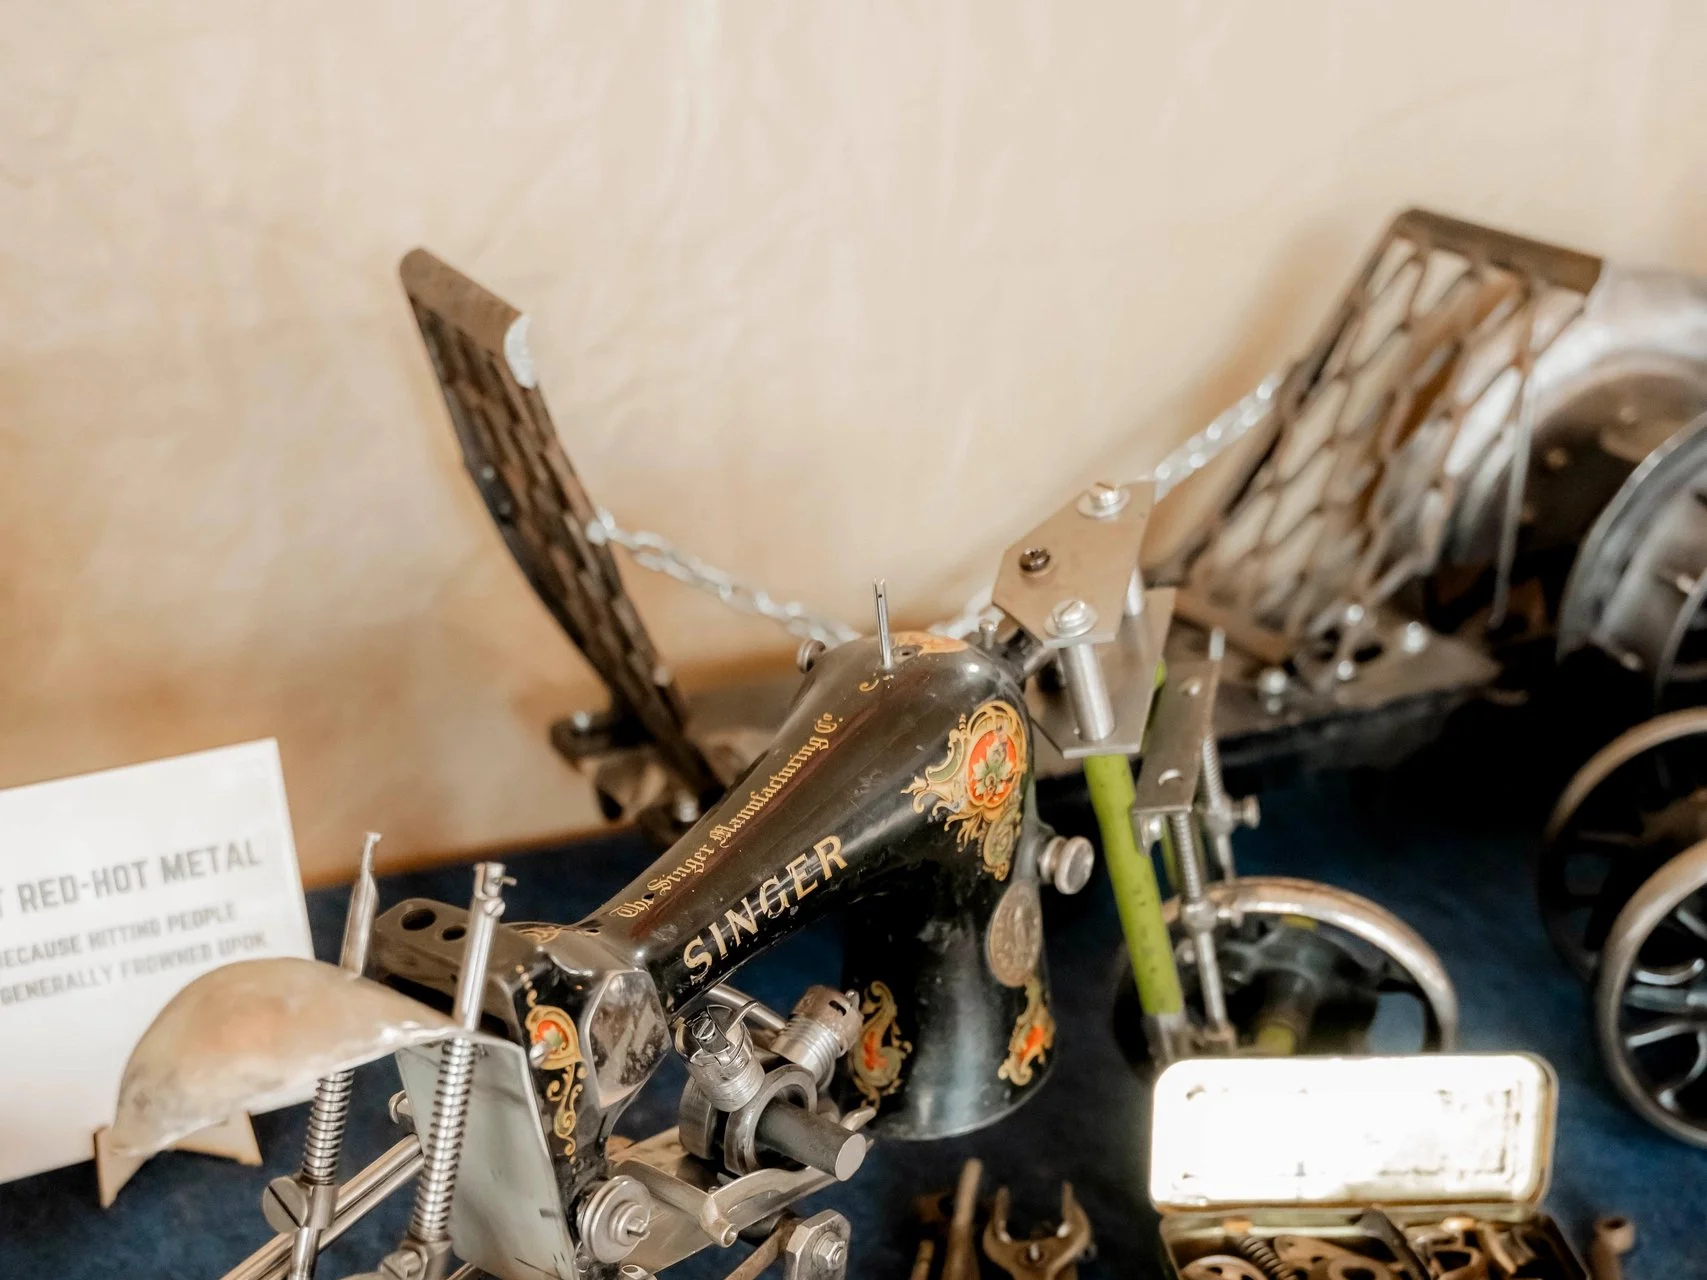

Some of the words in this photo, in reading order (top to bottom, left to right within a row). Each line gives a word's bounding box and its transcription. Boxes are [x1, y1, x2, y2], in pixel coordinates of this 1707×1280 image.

[647, 843, 715, 896] Singer
[709, 735, 830, 849] Manufacturing
[16, 858, 149, 914] RED-HOT
[160, 841, 262, 884] METAL
[683, 834, 849, 986] SINGER
[0, 933, 84, 969] ECAUSE
[87, 915, 162, 950] HITTING
[167, 902, 236, 933] PEOPLE
[0, 963, 113, 1007] GENERALLY
[120, 941, 212, 980] FROWNED
